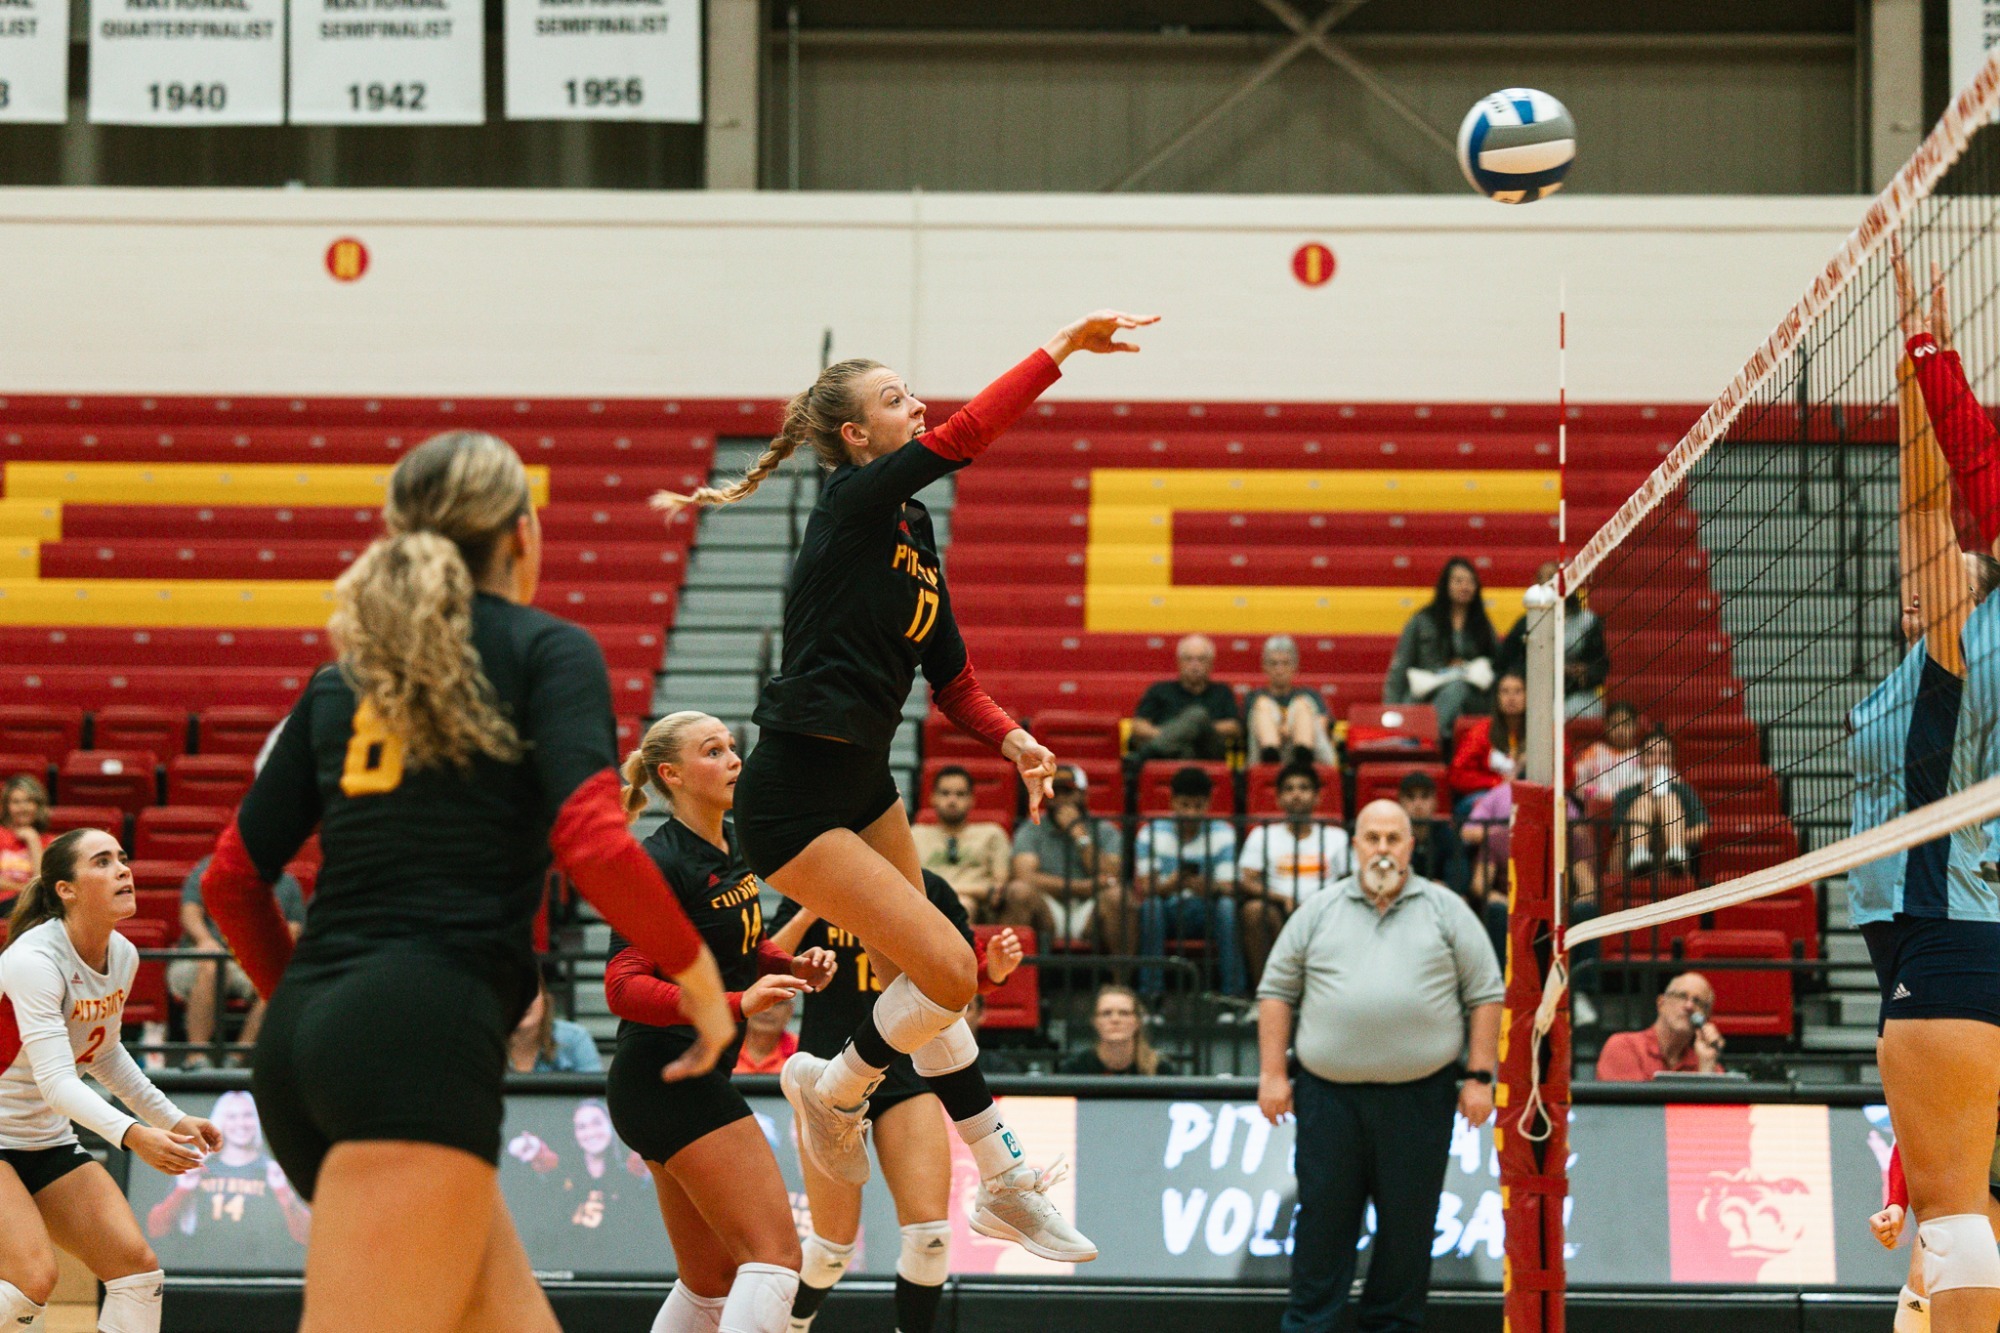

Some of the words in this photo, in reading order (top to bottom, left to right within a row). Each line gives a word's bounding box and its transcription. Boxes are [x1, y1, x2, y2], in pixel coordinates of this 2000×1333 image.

[101, 20, 274, 39] QUARTERFINALIST
[319, 20, 453, 39] SEMIFINALIST
[535, 16, 668, 35] SEMIFINALIST
[148, 82, 227, 111] 1940
[349, 82, 426, 111] 1942
[565, 77, 643, 106] 1956
[904, 587, 939, 642] 17
[741, 902, 762, 954] 14
[76, 1026, 106, 1064] 2
[212, 1193, 244, 1221] 14
